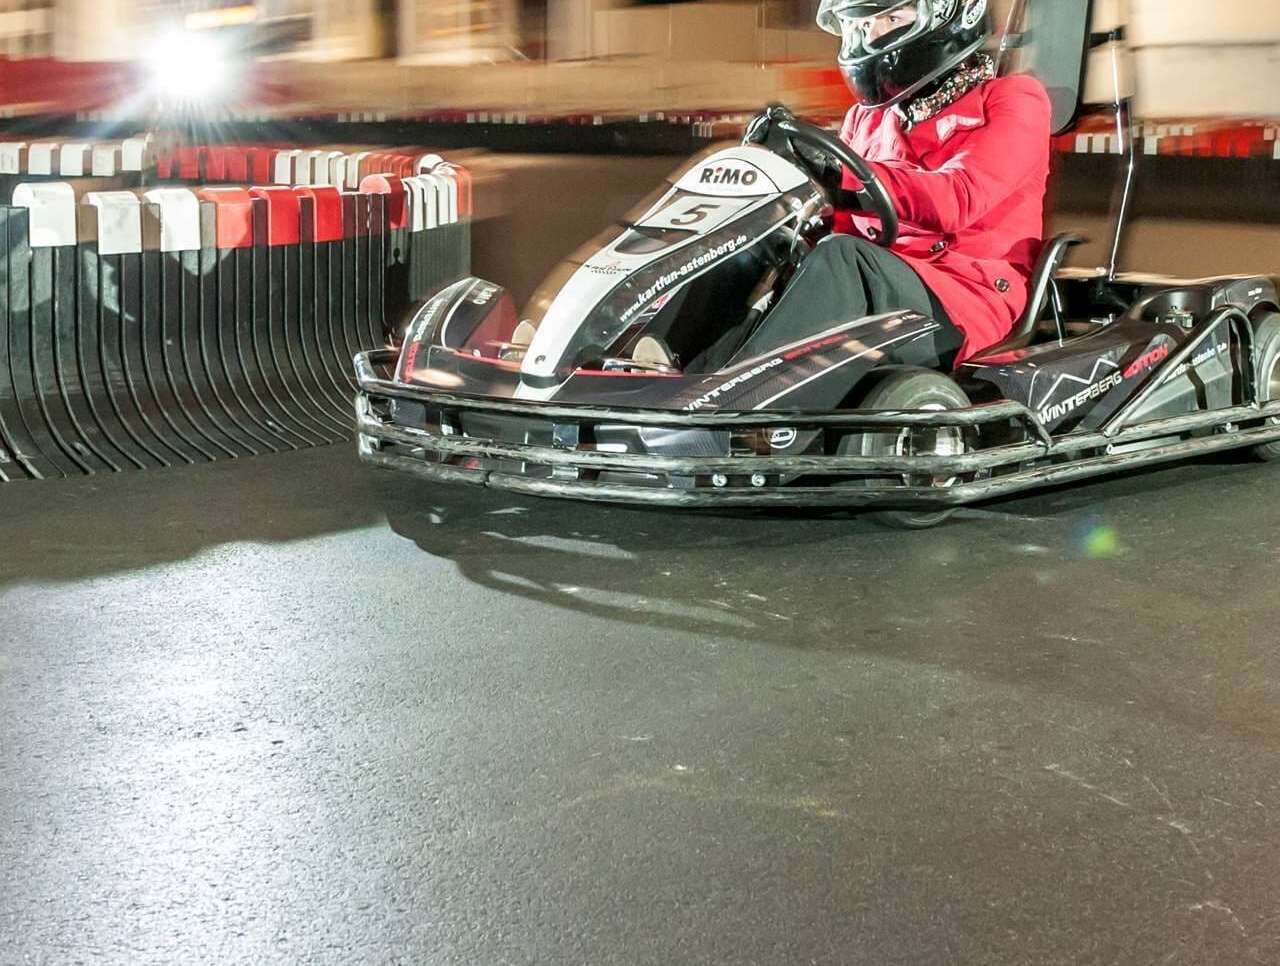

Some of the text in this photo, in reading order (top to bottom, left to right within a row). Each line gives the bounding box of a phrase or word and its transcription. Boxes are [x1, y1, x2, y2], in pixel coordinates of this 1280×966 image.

[670, 204, 721, 225] 5
[619, 234, 747, 322] www.kartfun-astenberg.de
[1037, 371, 1123, 425] WINTERBERG
